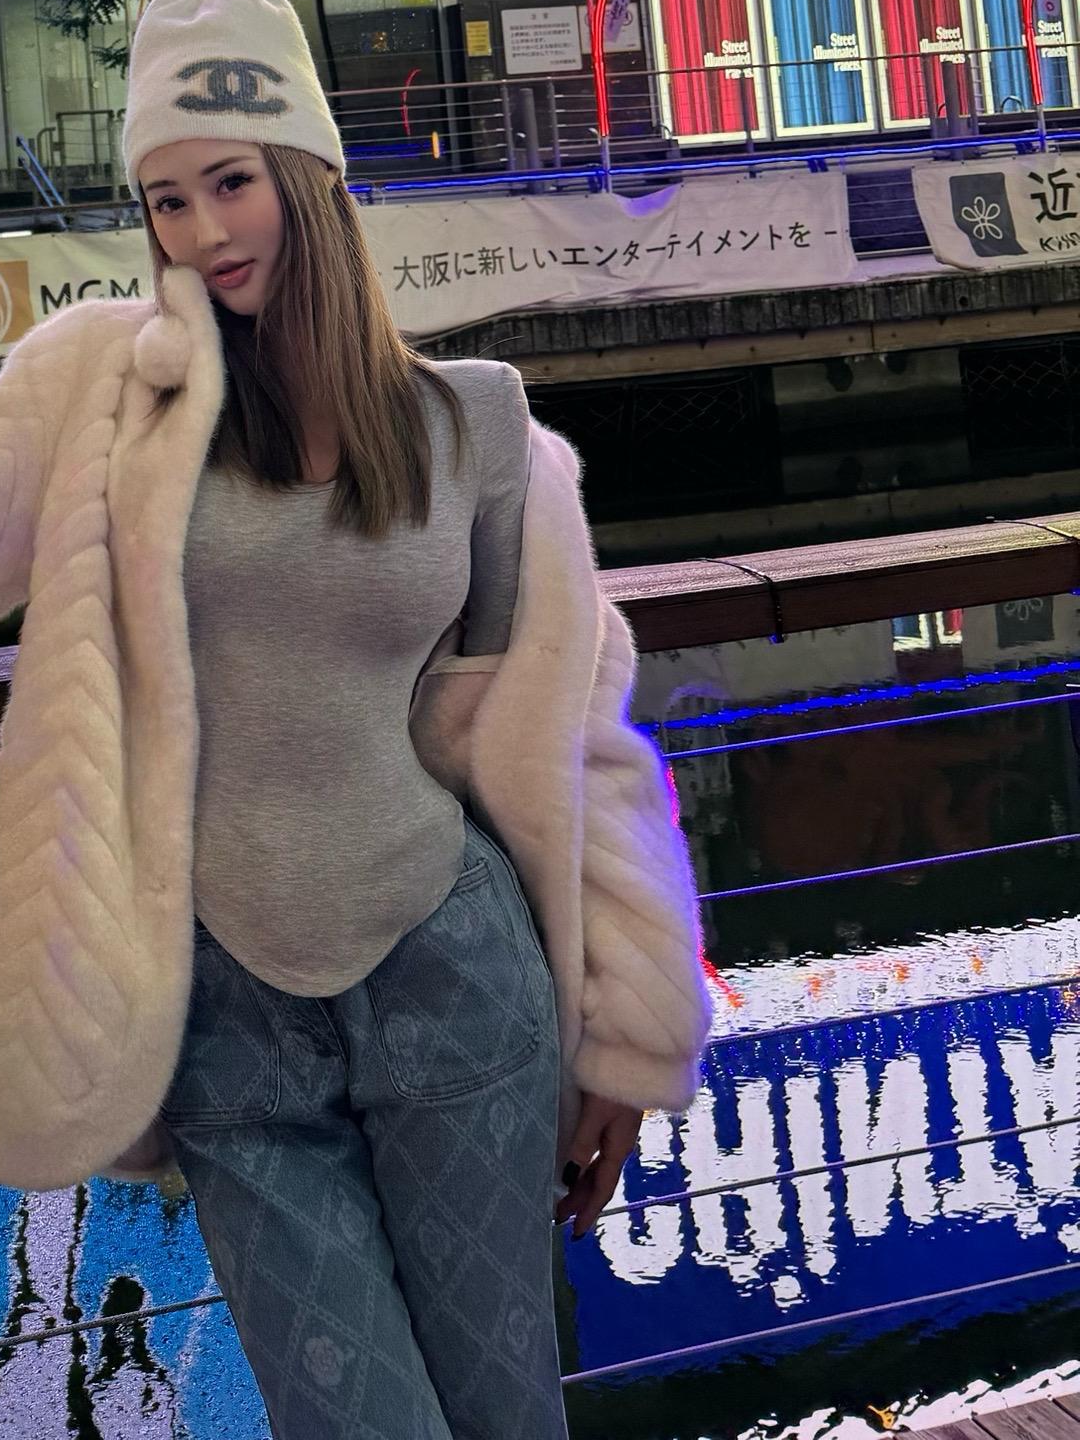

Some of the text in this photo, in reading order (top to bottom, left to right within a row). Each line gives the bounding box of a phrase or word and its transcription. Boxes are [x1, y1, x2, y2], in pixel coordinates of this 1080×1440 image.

[830, 33, 856, 46] Street
[721, 40, 748, 53] Street
[1028, 168, 1079, 223] 近
